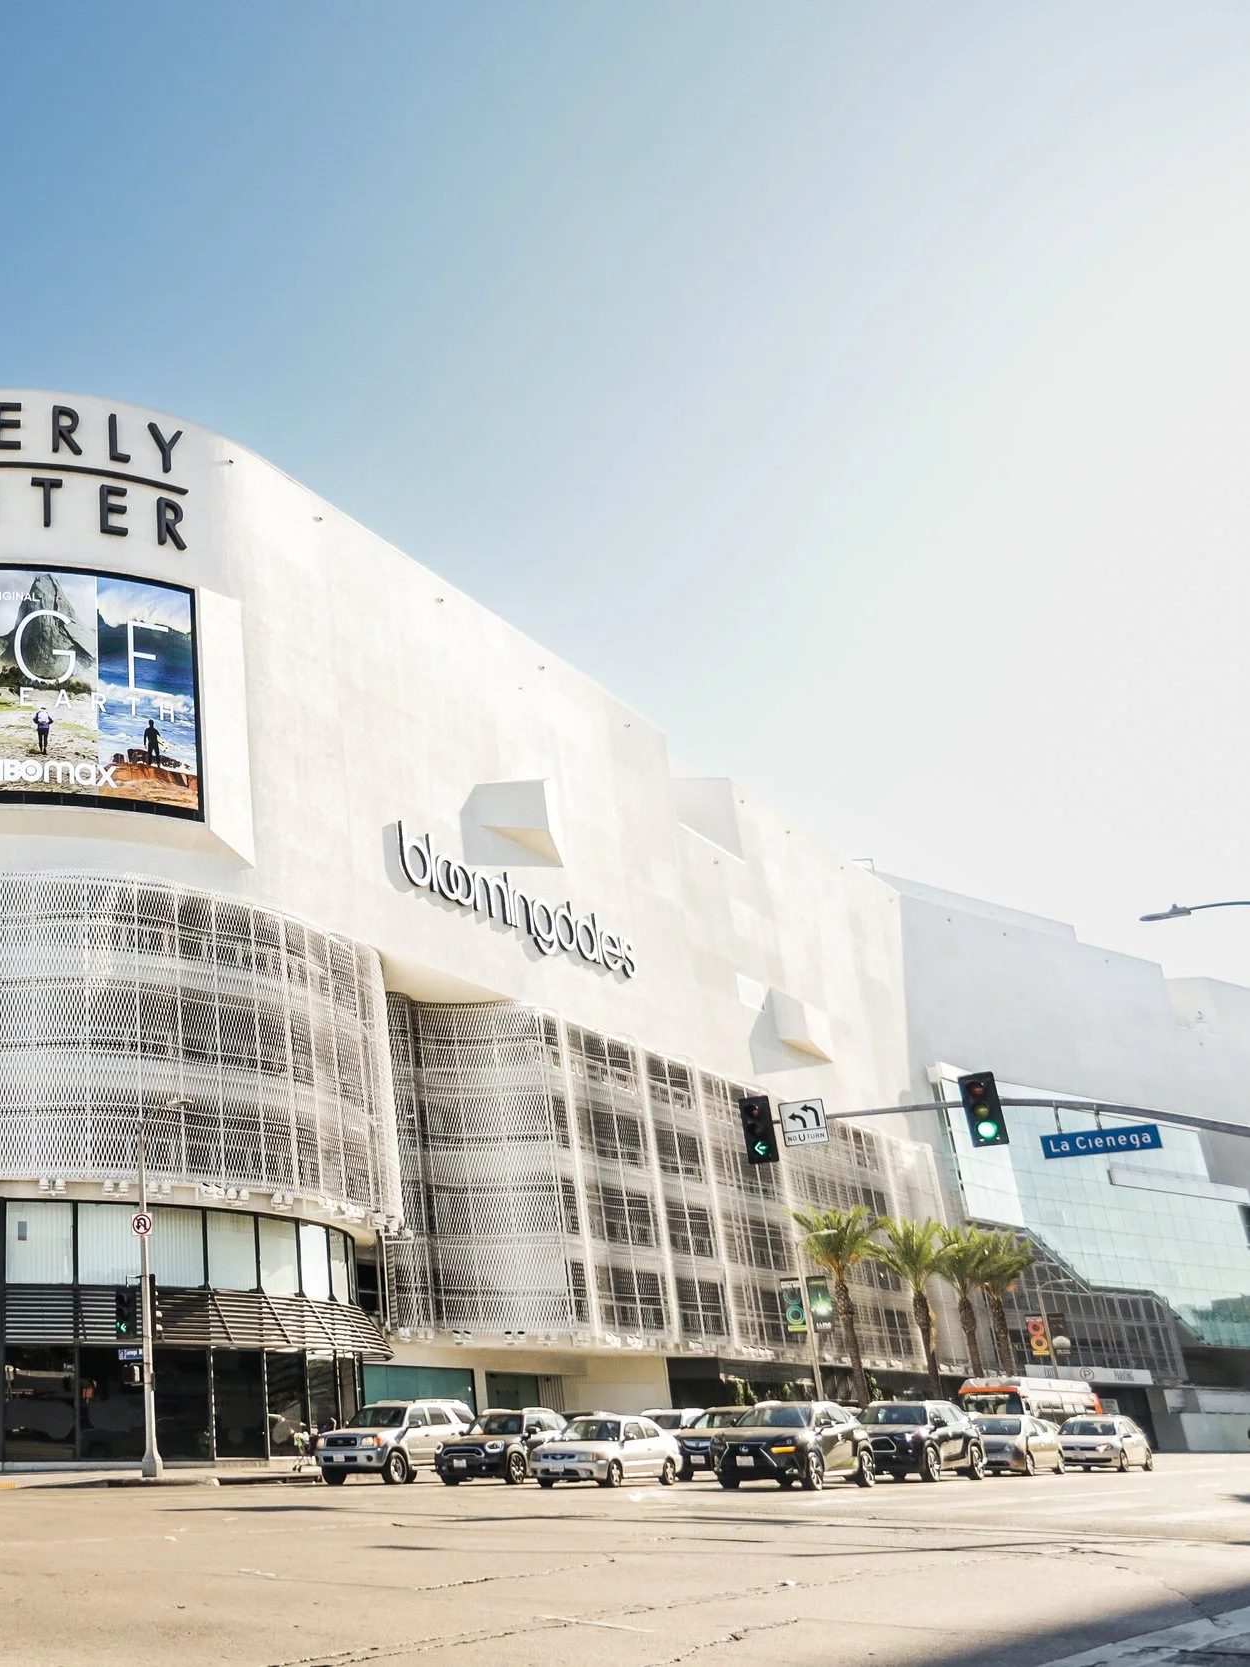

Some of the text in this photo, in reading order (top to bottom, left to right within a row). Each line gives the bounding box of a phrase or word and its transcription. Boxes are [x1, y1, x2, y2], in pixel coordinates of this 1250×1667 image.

[18, 687, 175, 723] EARTH
[798, 1133, 807, 1142] U
[1049, 1131, 1152, 1153] La Cienega
[1113, 1369, 1135, 1382] PARKING
